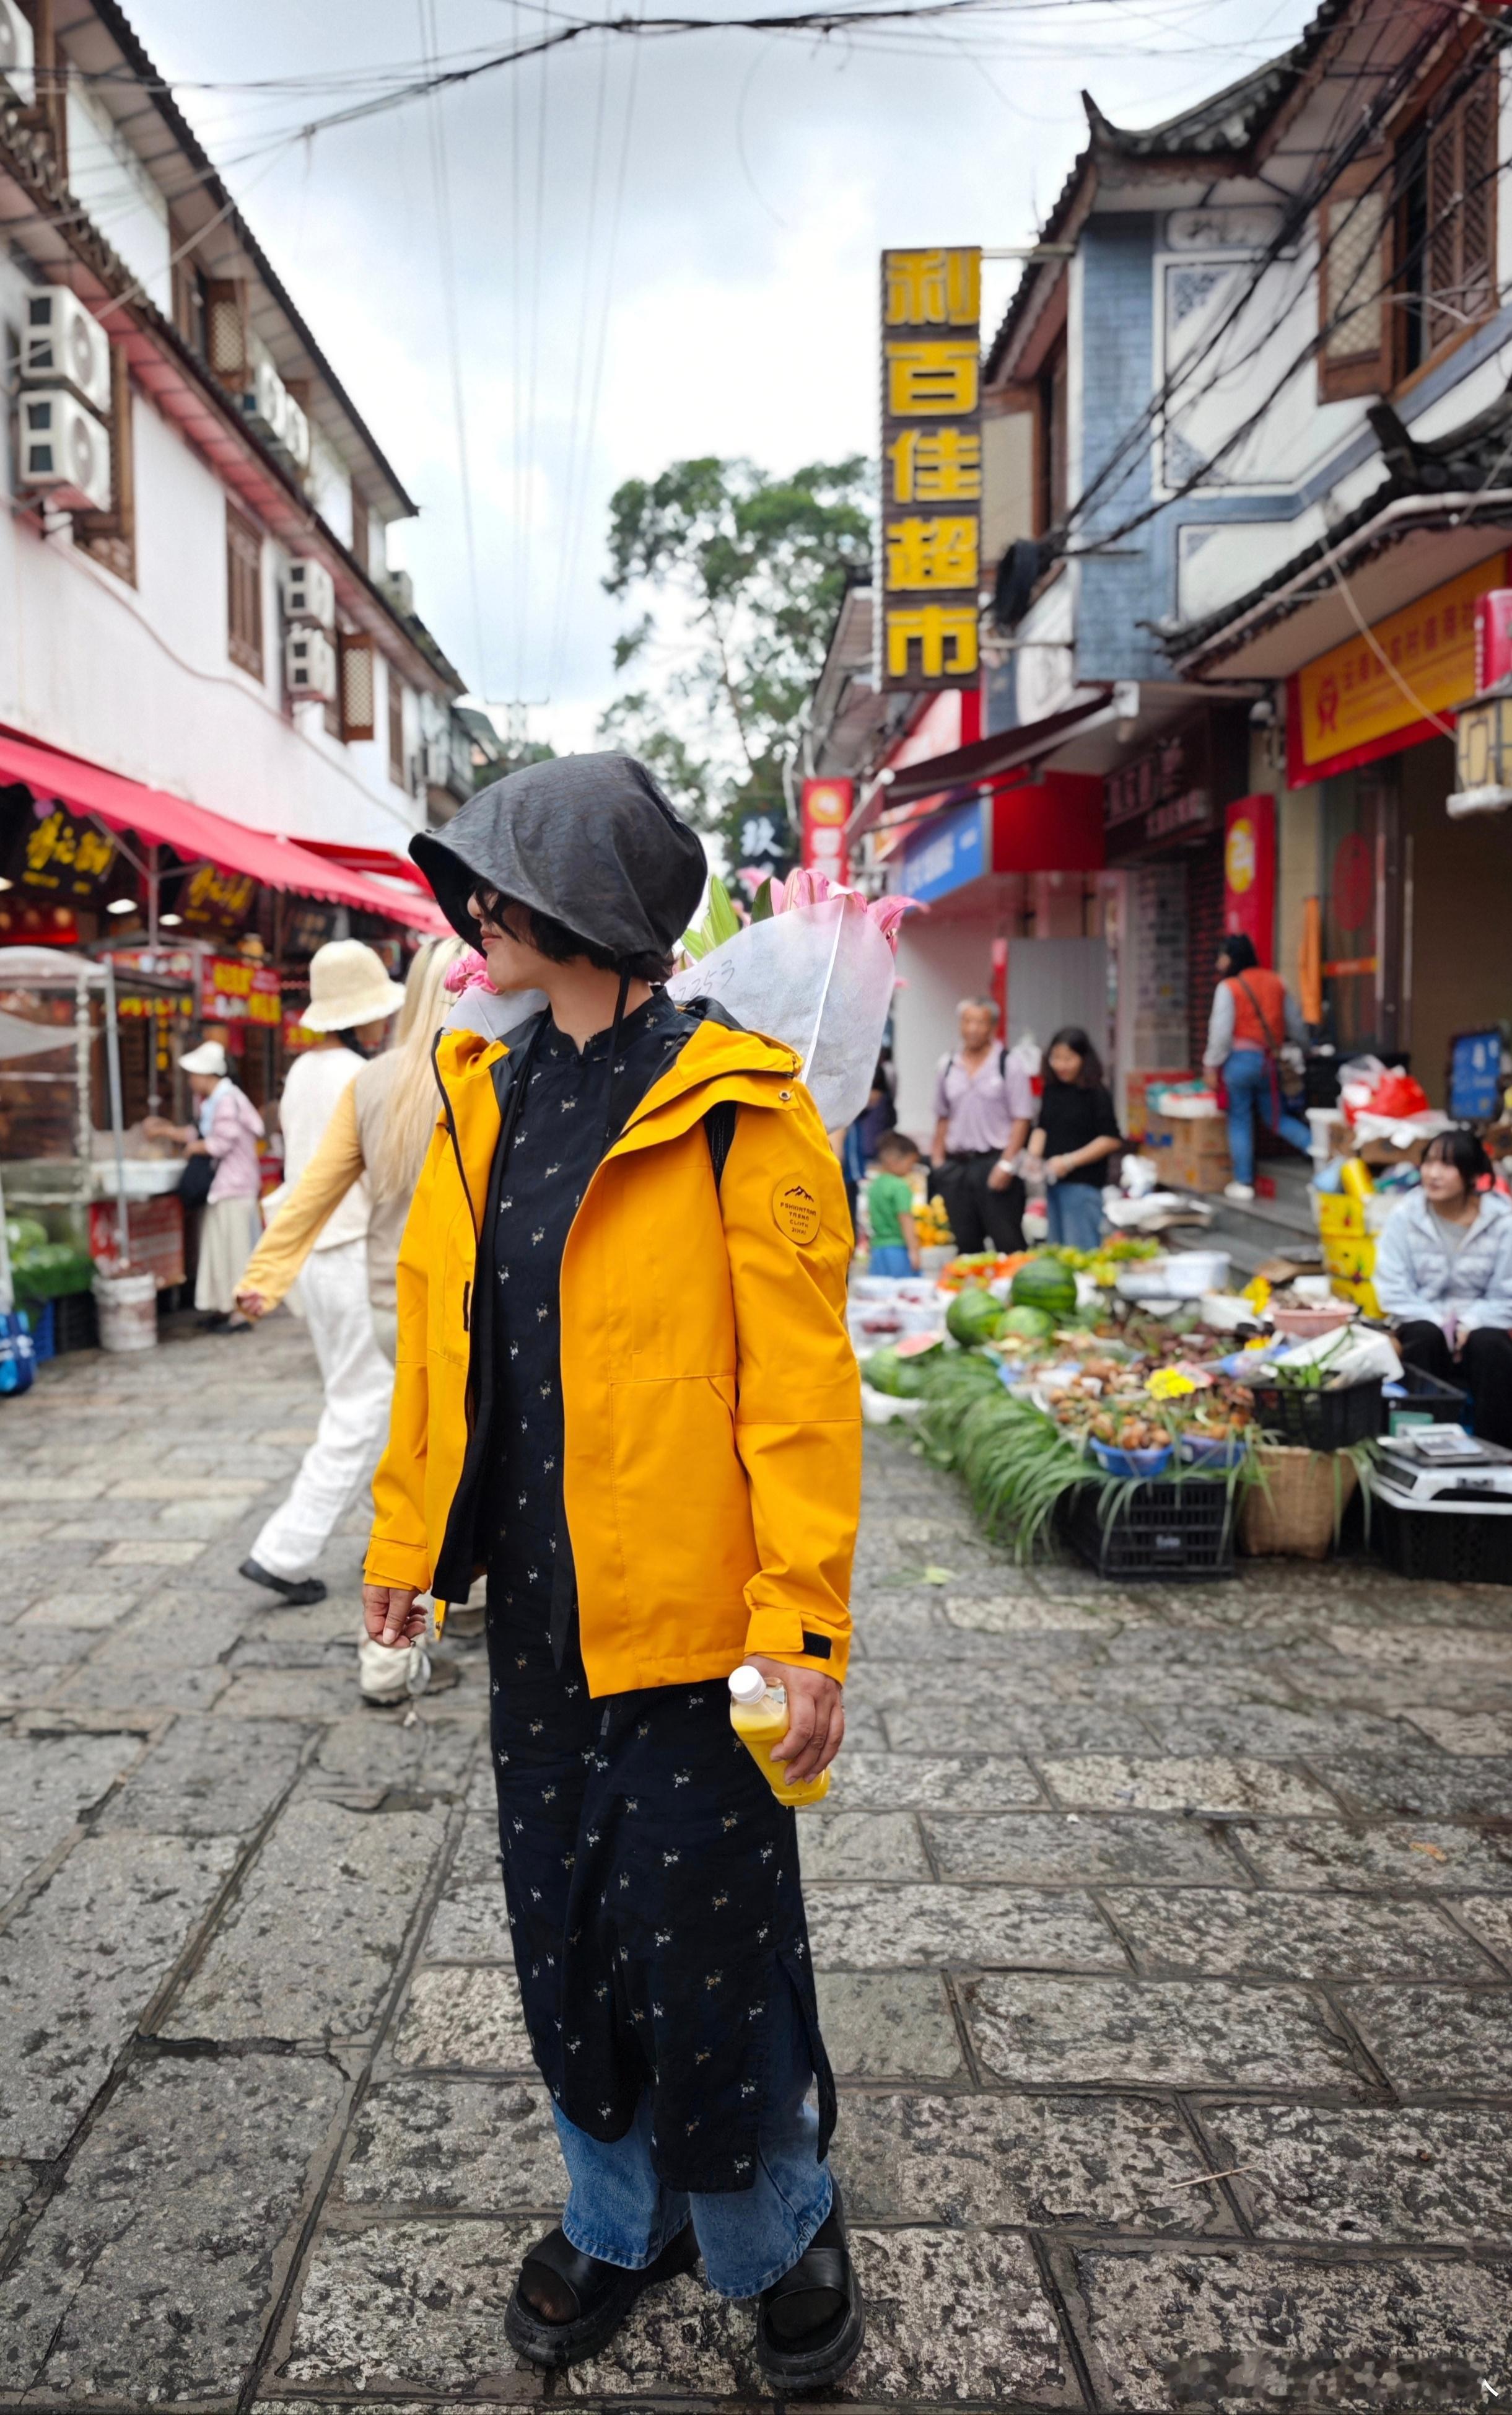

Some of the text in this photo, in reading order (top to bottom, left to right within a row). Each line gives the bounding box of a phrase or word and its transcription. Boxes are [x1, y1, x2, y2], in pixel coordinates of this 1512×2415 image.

[885, 249, 980, 677] 利百佳超市
